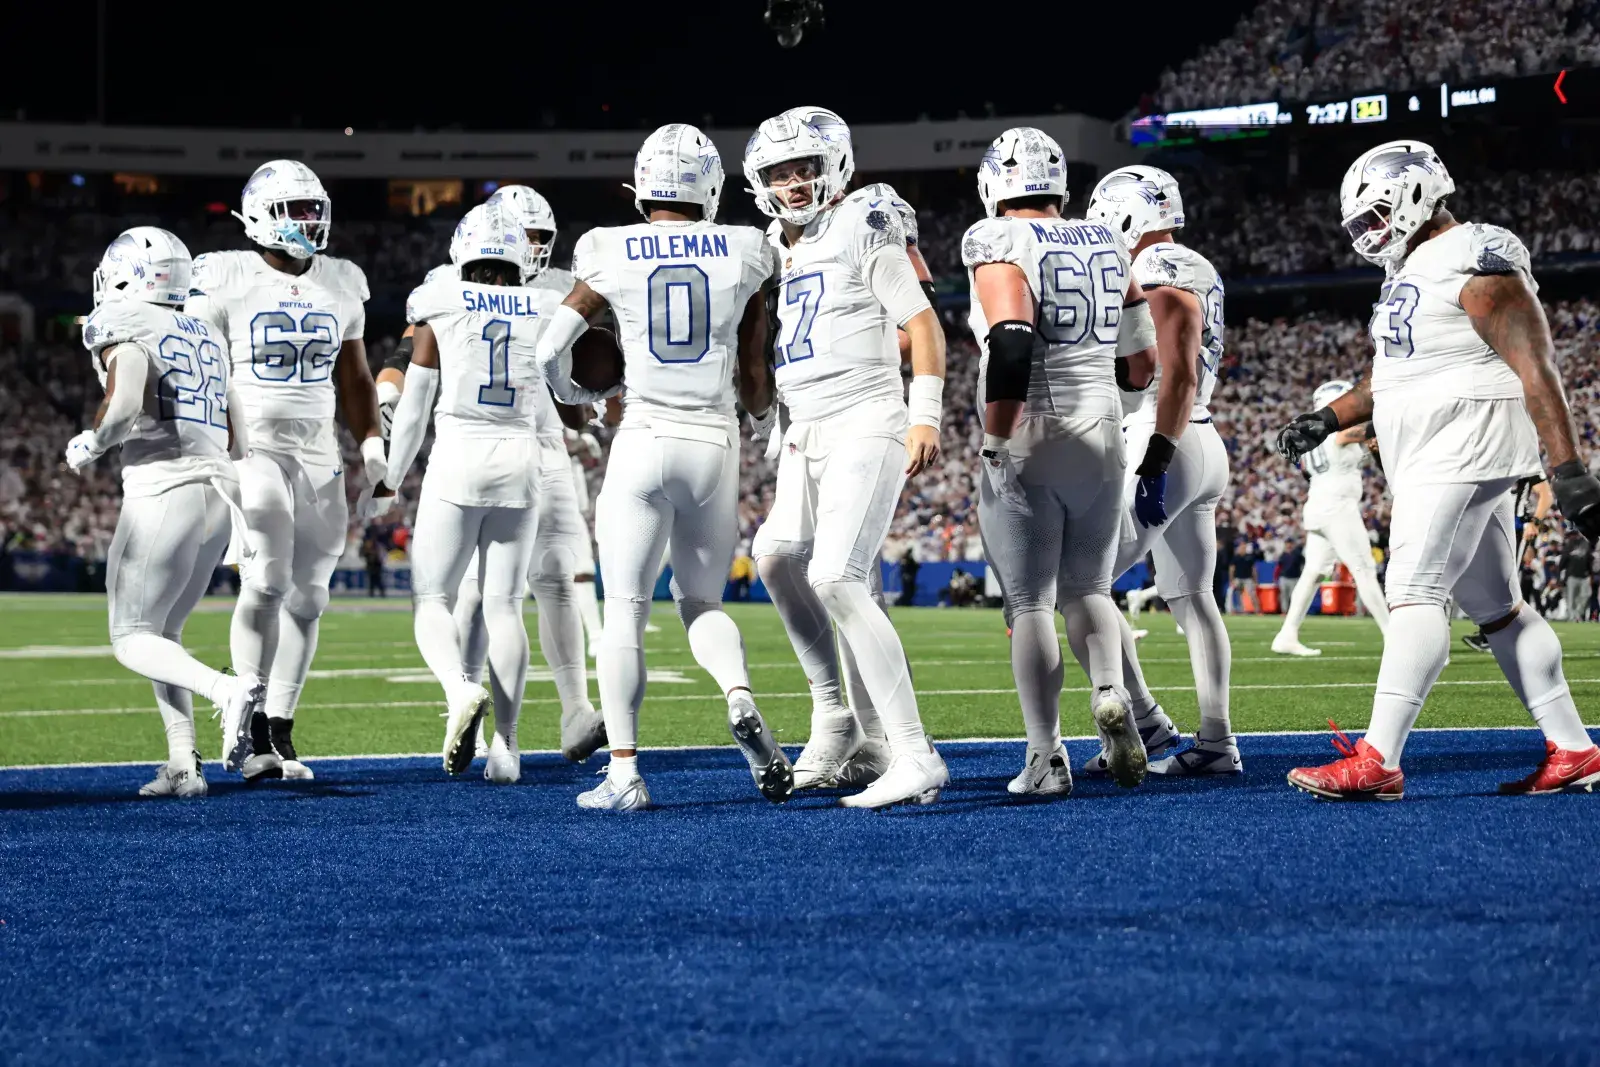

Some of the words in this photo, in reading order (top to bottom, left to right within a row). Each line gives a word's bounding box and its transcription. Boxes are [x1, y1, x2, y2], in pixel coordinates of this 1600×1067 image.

[1306, 102, 1348, 124] 7:37
[650, 190, 677, 198] BILLS
[1024, 183, 1050, 191] BILLS
[480, 247, 504, 255] BILLS
[625, 234, 729, 261] COLEMAN
[278, 301, 313, 309] BUFFALO
[462, 289, 538, 316] SAMUEL
[1036, 250, 1125, 345] 66
[647, 263, 711, 364] 0
[1367, 281, 1421, 359] 3
[250, 311, 342, 384] 62
[477, 318, 516, 407] 1
[158, 334, 229, 431] 22
